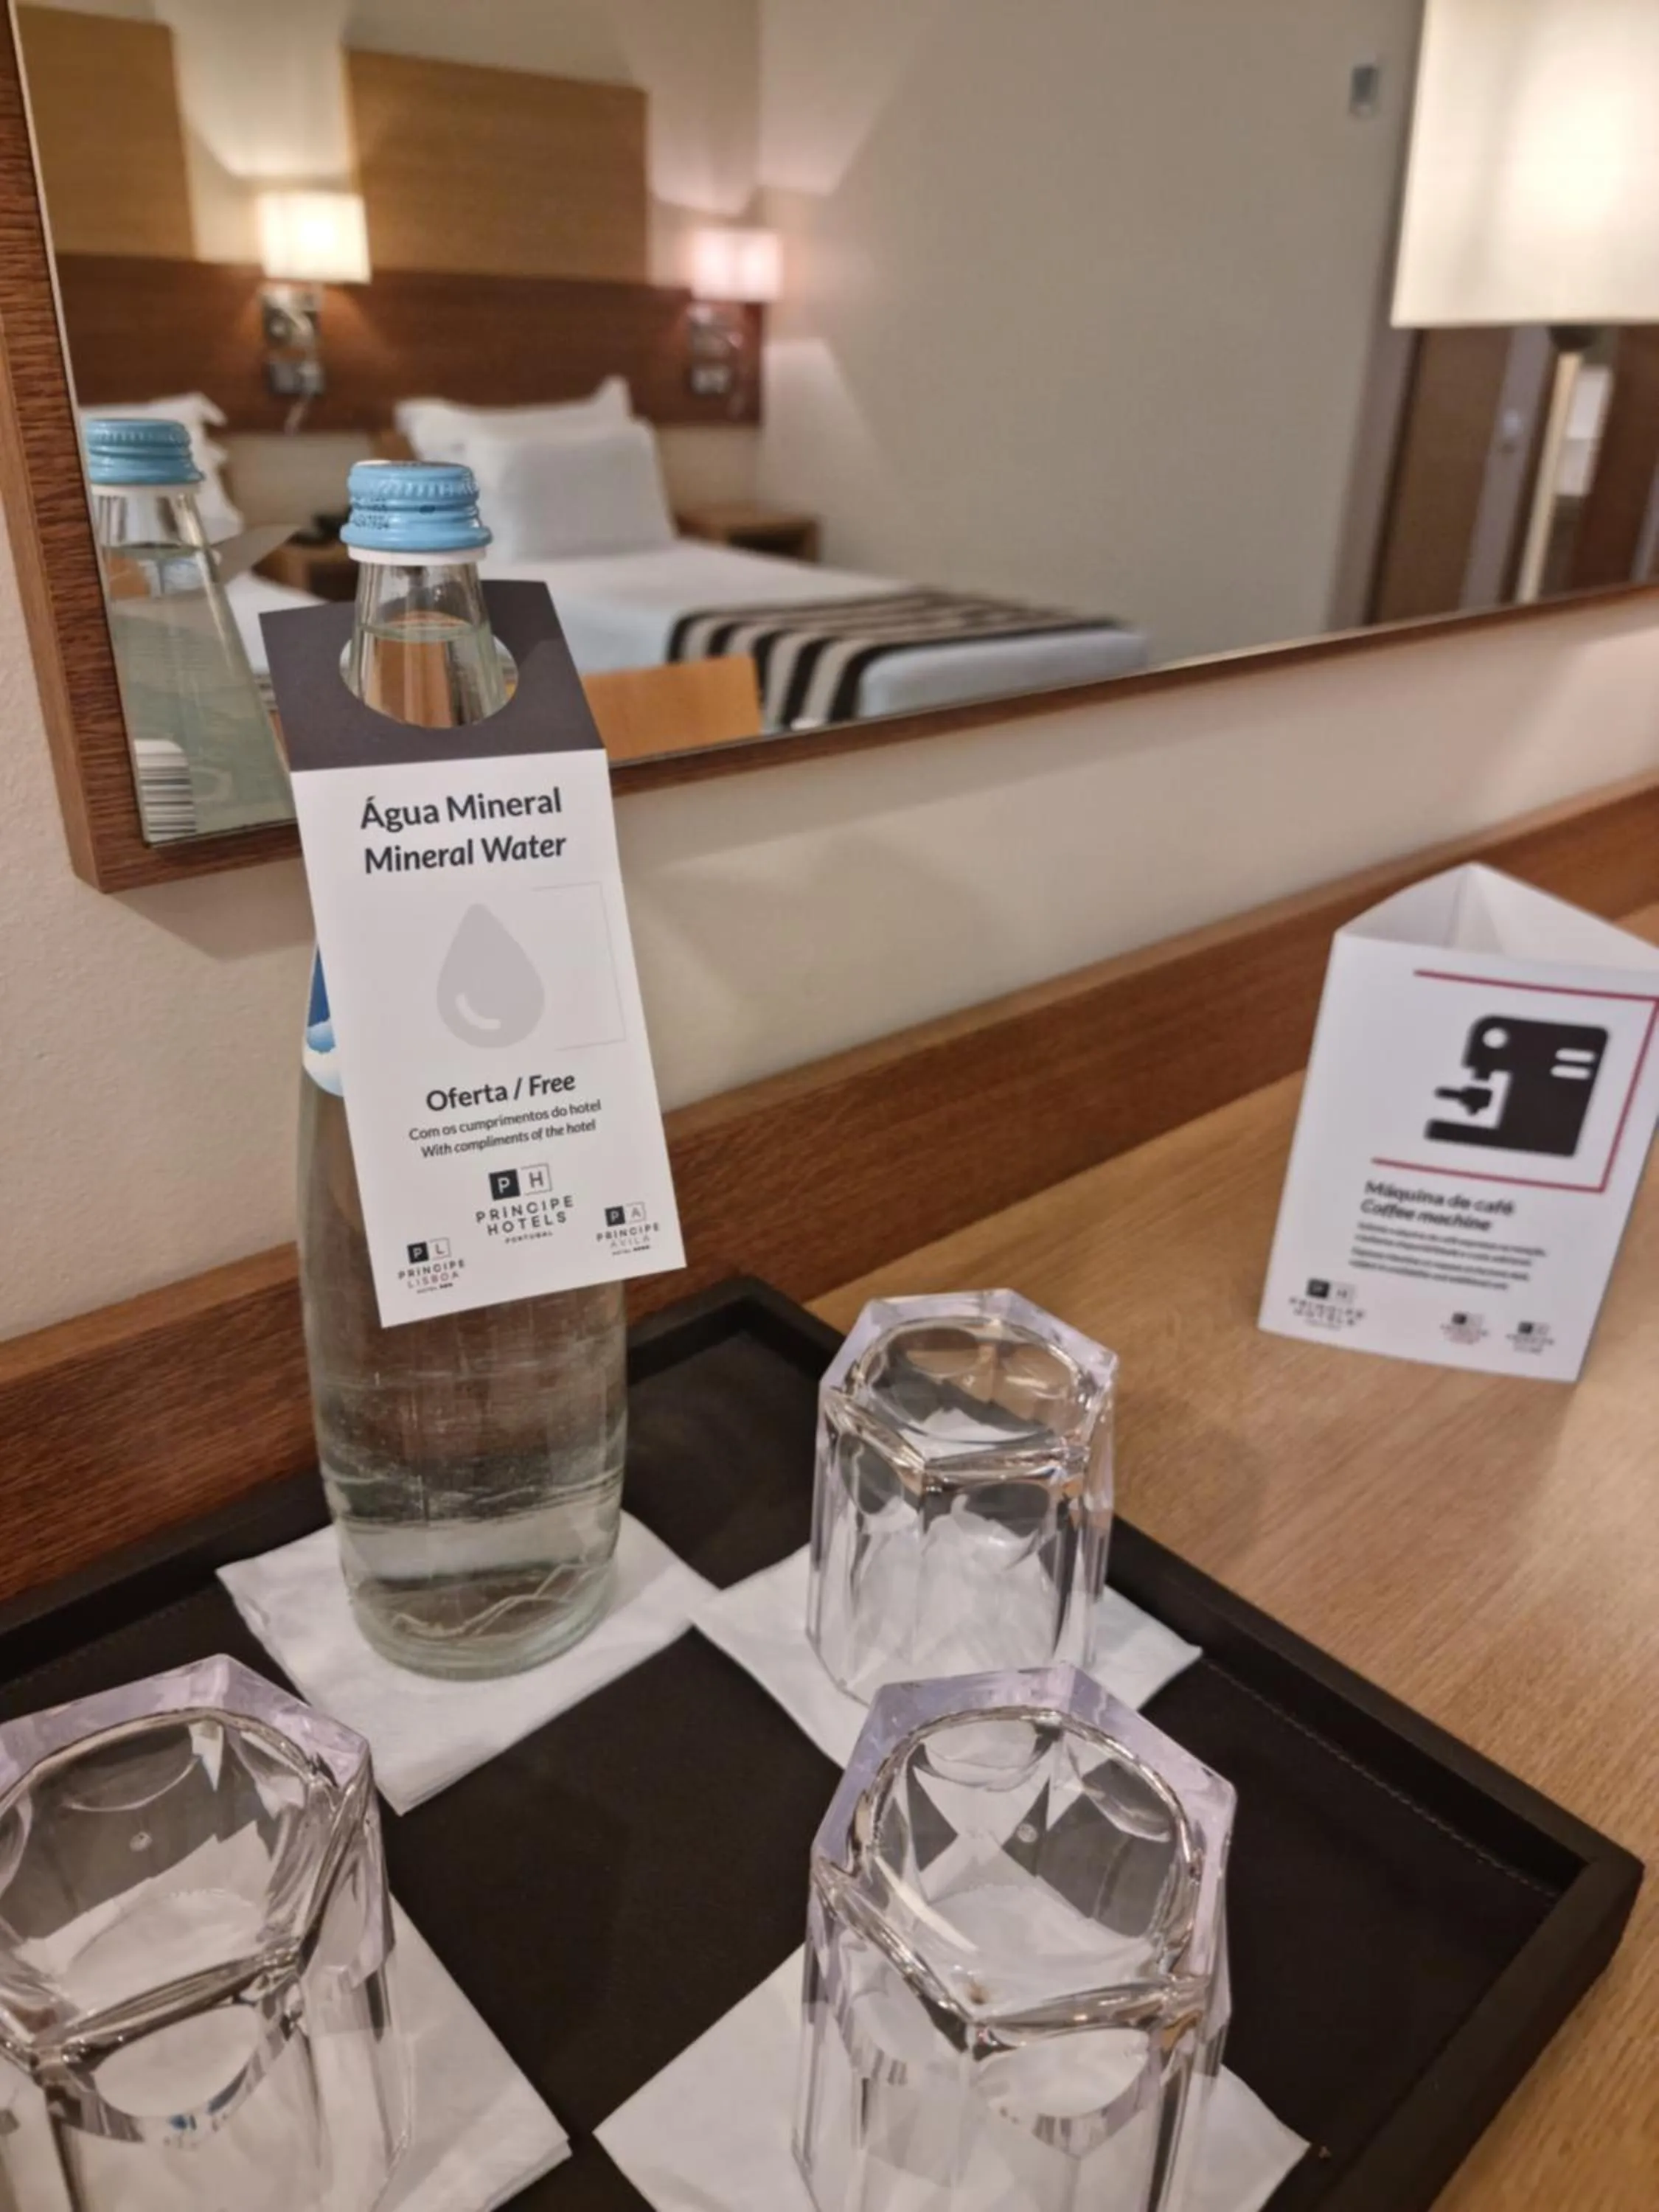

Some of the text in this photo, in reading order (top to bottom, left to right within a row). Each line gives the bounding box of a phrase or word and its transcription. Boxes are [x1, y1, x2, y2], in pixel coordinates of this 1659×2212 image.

[361, 787, 562, 832] Água Mineral
[365, 835, 566, 874] Mineral Water
[426, 1083, 508, 1111] Oferta
[529, 1074, 576, 1096] Free
[408, 1099, 602, 1141] Com os cumprimentos do hotel
[421, 1119, 596, 1158] With compliments of the hotel
[476, 1195, 574, 1222] PRINCIPE
[1360, 1197, 1492, 1231] Coffee machine
[1364, 1180, 1514, 1216] Máquina de café
[487, 1211, 566, 1236] HOTELS
